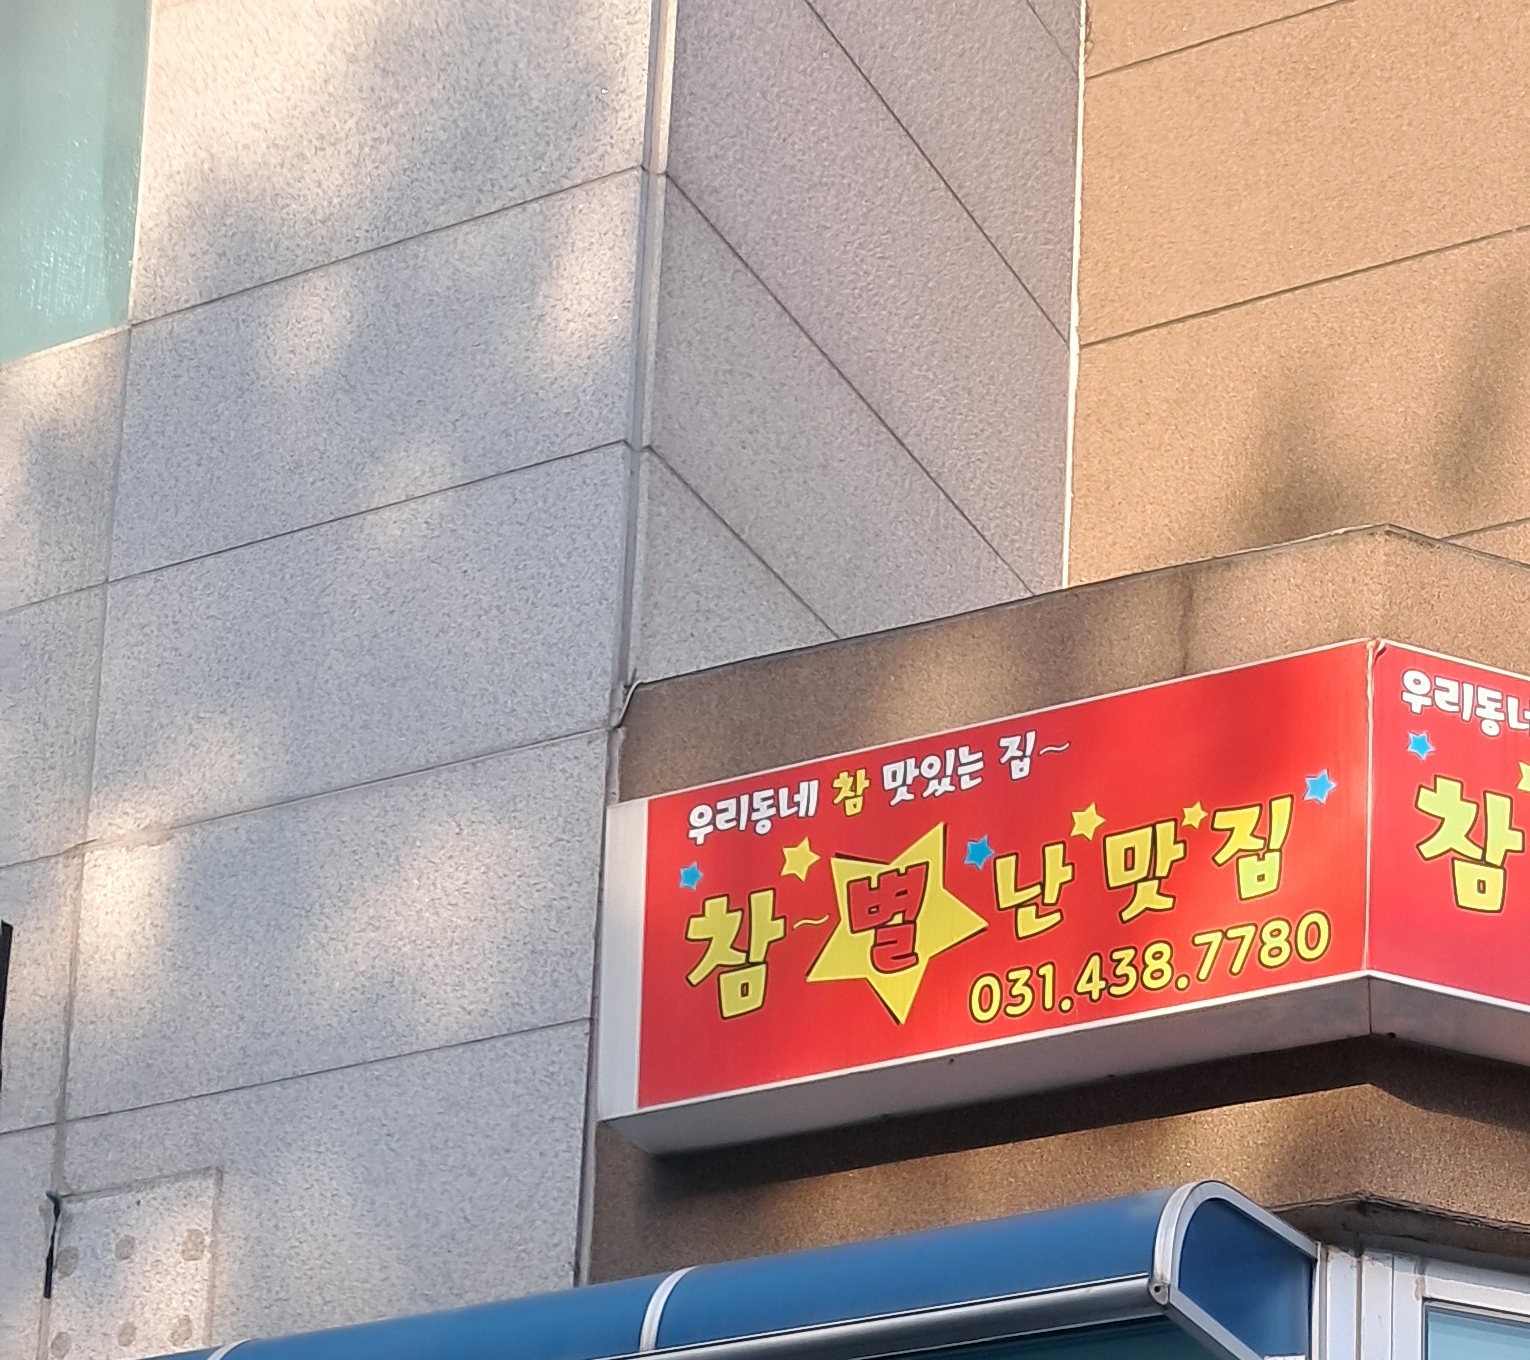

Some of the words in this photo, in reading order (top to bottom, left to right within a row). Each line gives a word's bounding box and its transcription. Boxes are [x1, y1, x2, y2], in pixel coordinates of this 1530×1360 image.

[687, 781, 818, 844] 우리동네
[831, 770, 869, 818] 참
[881, 746, 984, 806] 맛있는
[968, 910, 1331, 1023] 031.438.7780
